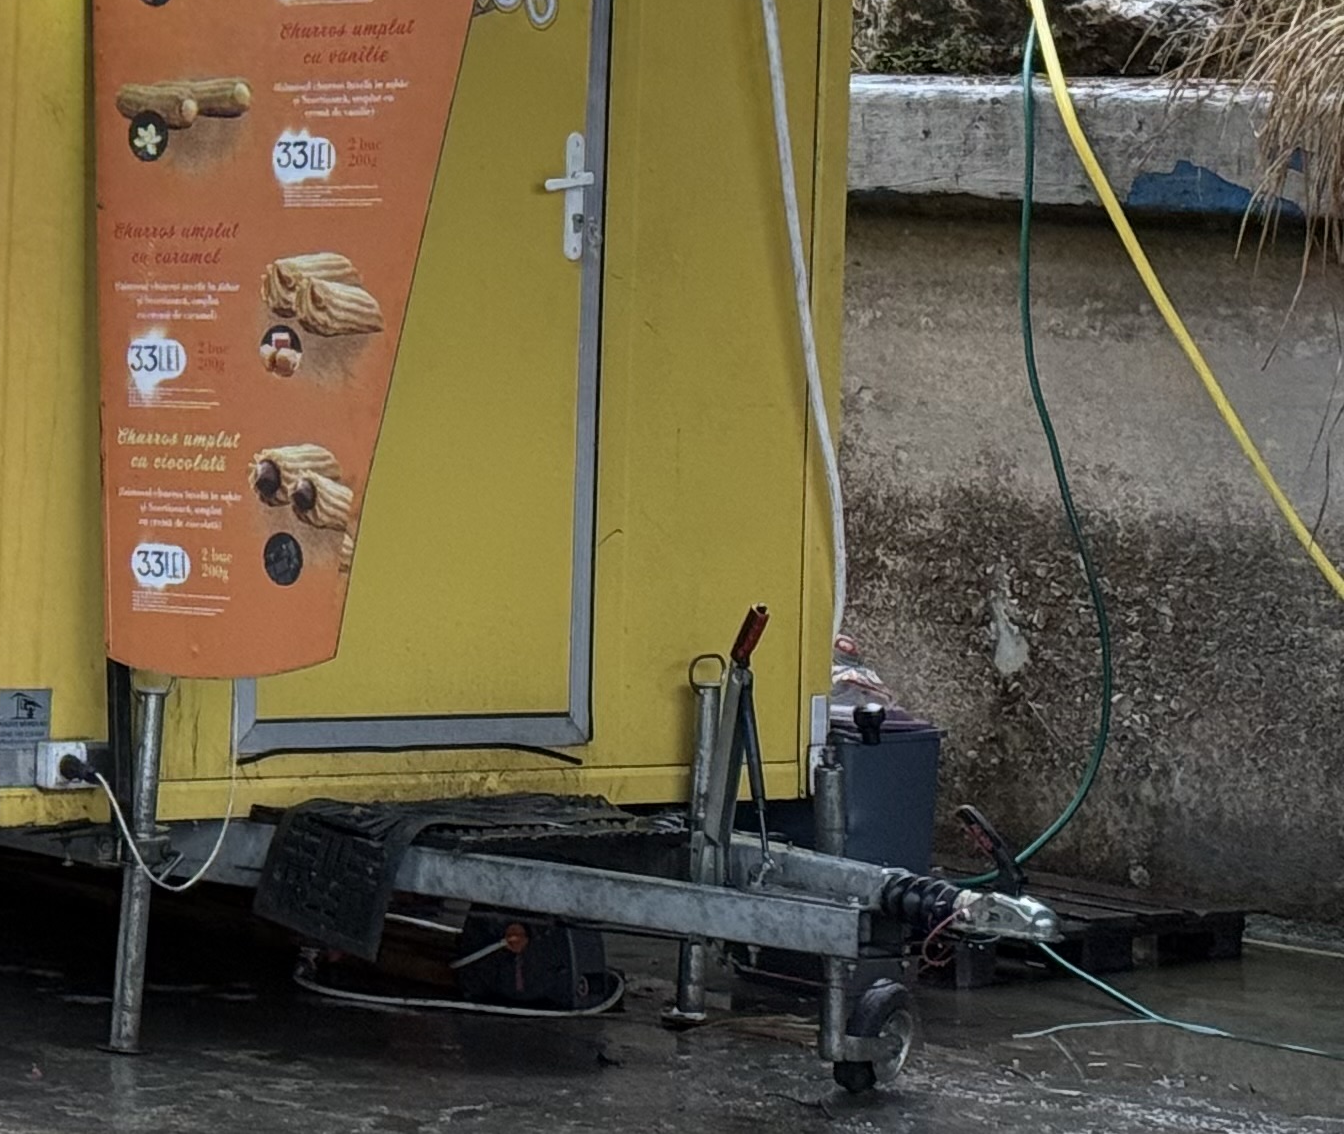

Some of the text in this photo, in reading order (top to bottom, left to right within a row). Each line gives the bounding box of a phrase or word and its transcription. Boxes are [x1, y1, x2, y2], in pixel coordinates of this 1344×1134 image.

[280, 18, 416, 41] Churros umplut
[113, 221, 176, 241] Churros
[116, 426, 241, 450] Churros umplut
